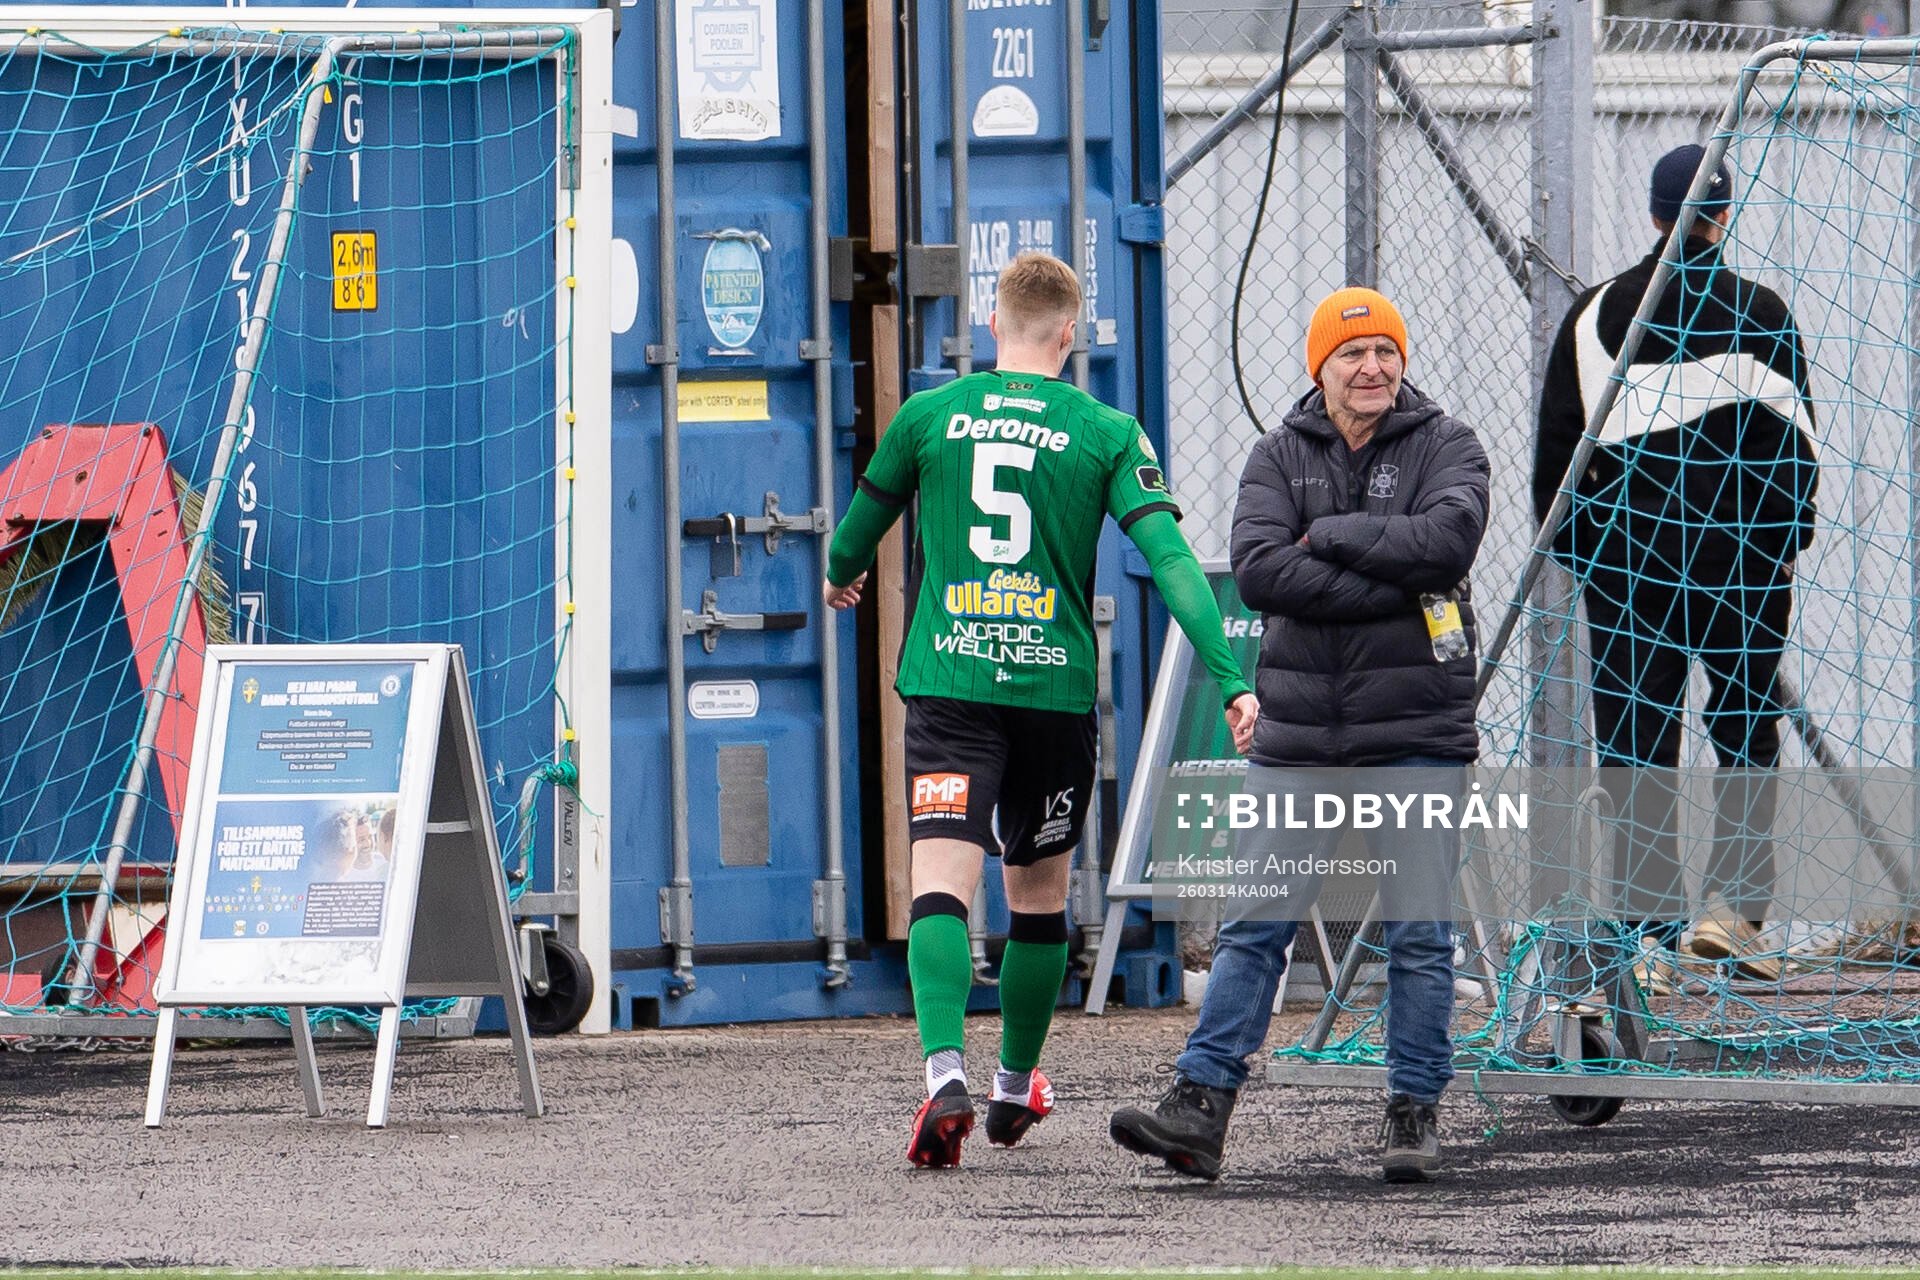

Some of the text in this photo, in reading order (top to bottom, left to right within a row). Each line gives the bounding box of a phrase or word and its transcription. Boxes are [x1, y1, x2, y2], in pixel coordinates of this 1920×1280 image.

[704, 23, 749, 35] CONTAINER
[710, 38, 744, 50] POOLEN
[992, 28, 1034, 78] 22G1
[705, 272, 760, 289] PATENTED
[714, 288, 752, 305] DESIGN
[946, 413, 1070, 452] Derome
[968, 442, 1037, 565] 5
[988, 569, 1041, 593] Gekås
[945, 581, 1056, 620] Ullared
[953, 620, 1044, 644] NORDIC
[935, 633, 1067, 666] WELLNESS
[915, 776, 966, 805] FMP
[1045, 787, 1074, 820] VS
[223, 825, 304, 841] TILLSAMMANS
[564, 800, 575, 847] VALLEN
[240, 841, 262, 856] ETT
[219, 855, 300, 871] MATCHKLIMAT
